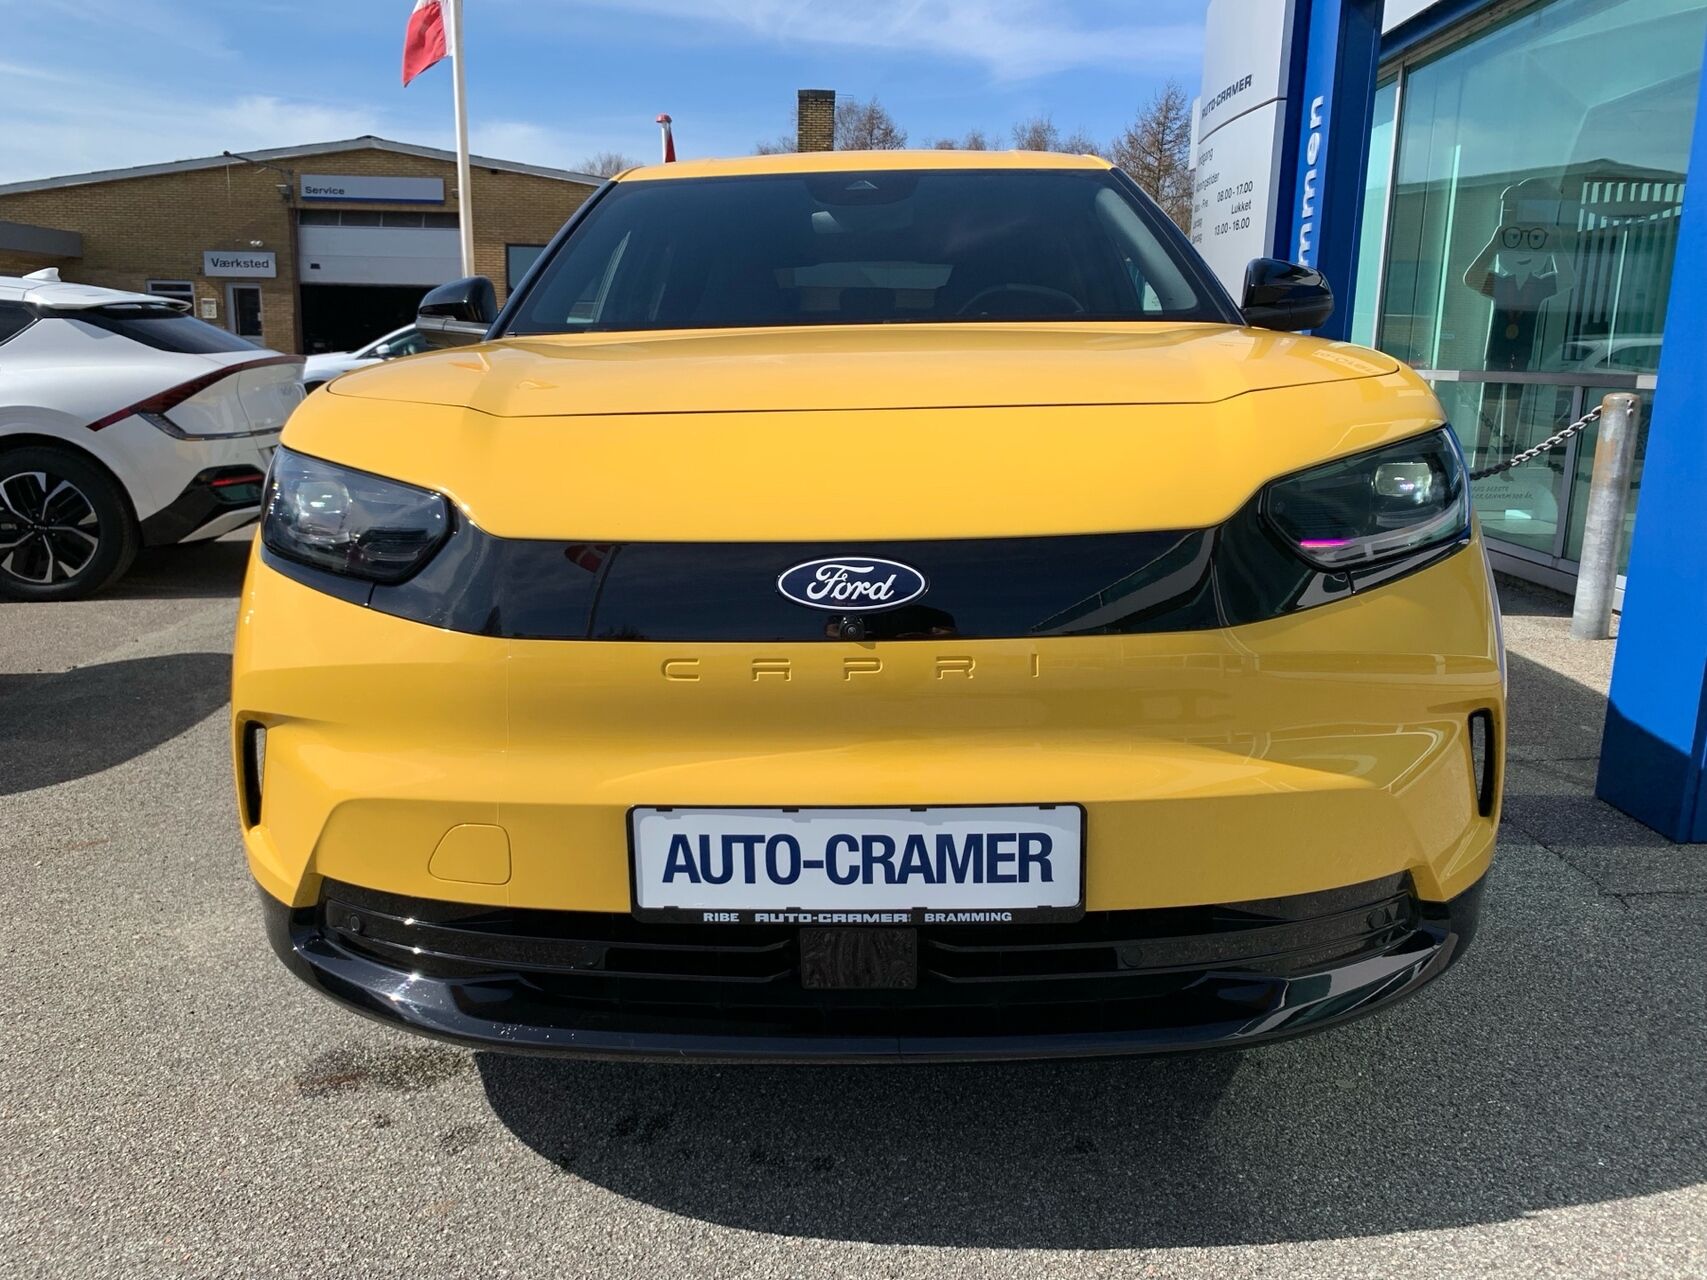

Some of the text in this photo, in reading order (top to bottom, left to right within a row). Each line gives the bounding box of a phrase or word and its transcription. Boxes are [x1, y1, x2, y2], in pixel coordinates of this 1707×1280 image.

[1202, 74, 1252, 118] AUTO-CRAMER
[305, 186, 345, 195] Service
[1231, 199, 1252, 215] Lukket
[211, 258, 270, 269] Værksted
[806, 562, 897, 601] Ford
[660, 653, 1041, 683] CAPRI
[661, 831, 1055, 885] AUTO-CRAMER
[703, 912, 1013, 924] RIBE AUTO-CRAMER BRAMMING
